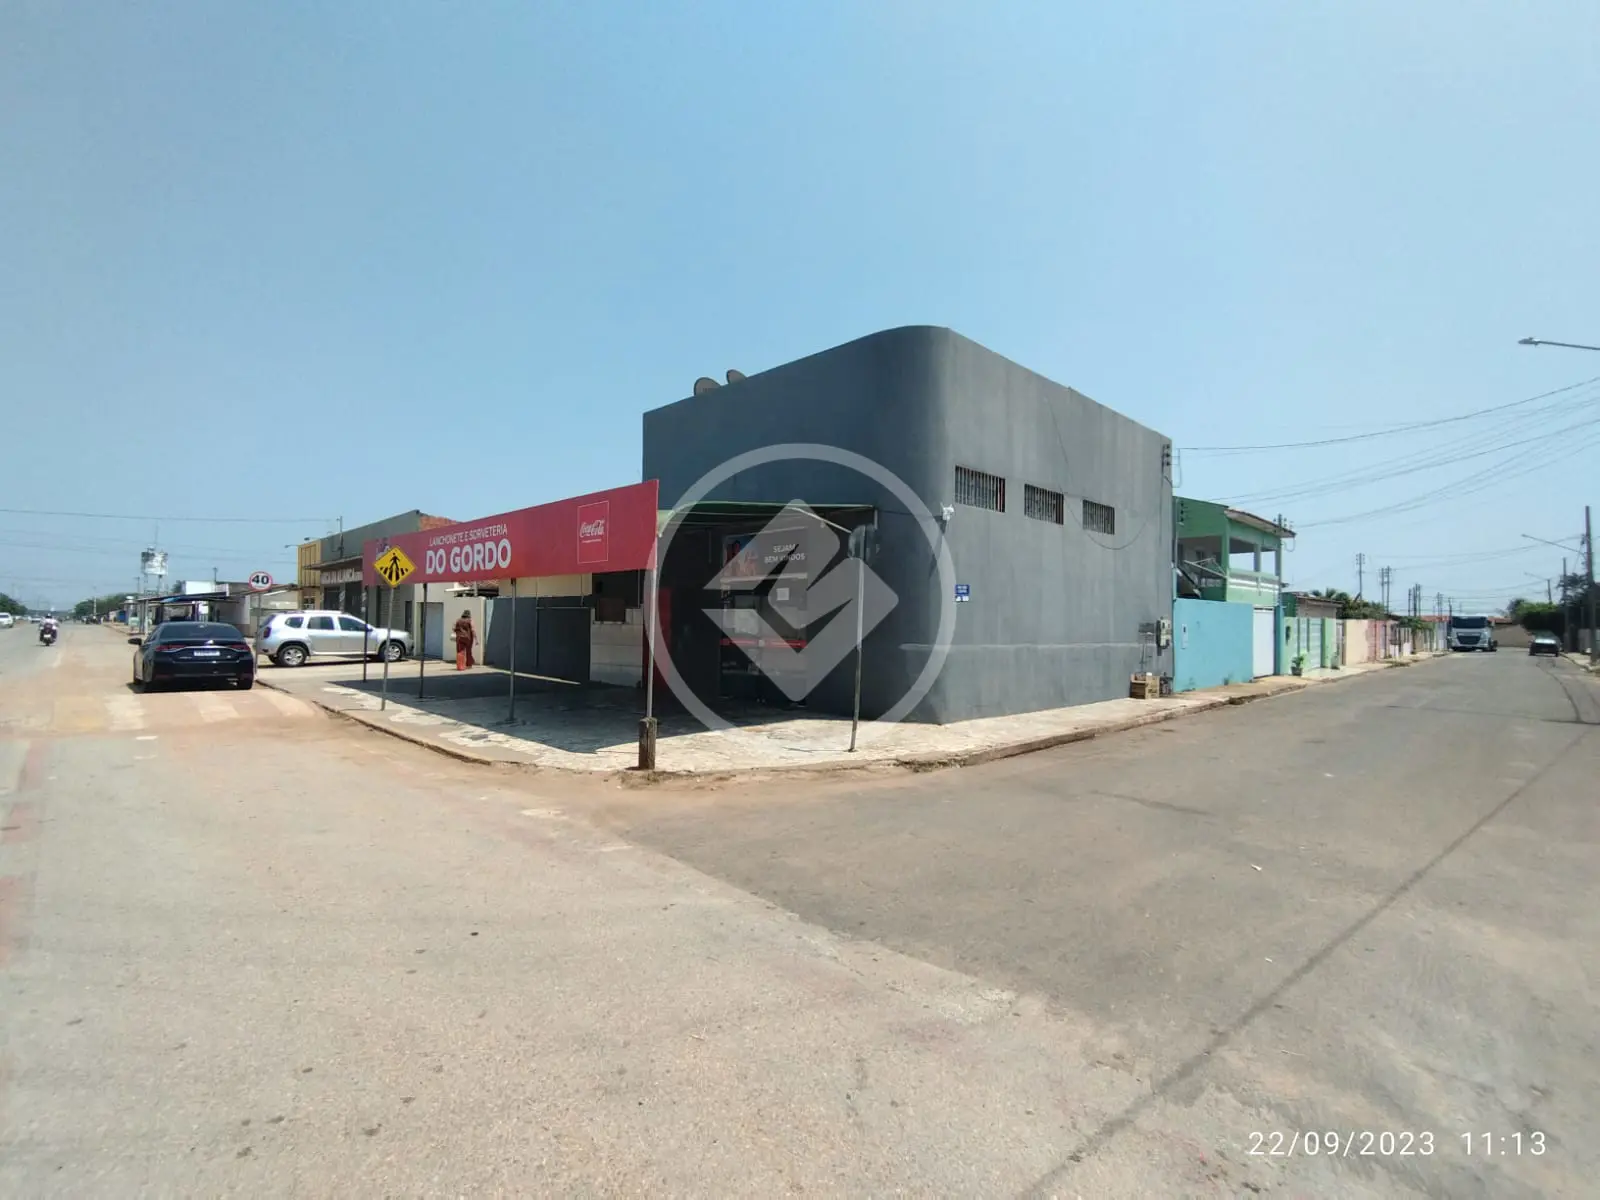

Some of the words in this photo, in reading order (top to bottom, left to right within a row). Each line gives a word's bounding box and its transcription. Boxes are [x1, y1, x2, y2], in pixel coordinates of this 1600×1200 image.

[428, 532, 464, 547] LANCHONETE
[469, 523, 508, 541] SORVETERIA
[425, 548, 447, 575] DO
[449, 538, 512, 573] GORDO
[251, 574, 270, 585] 40
